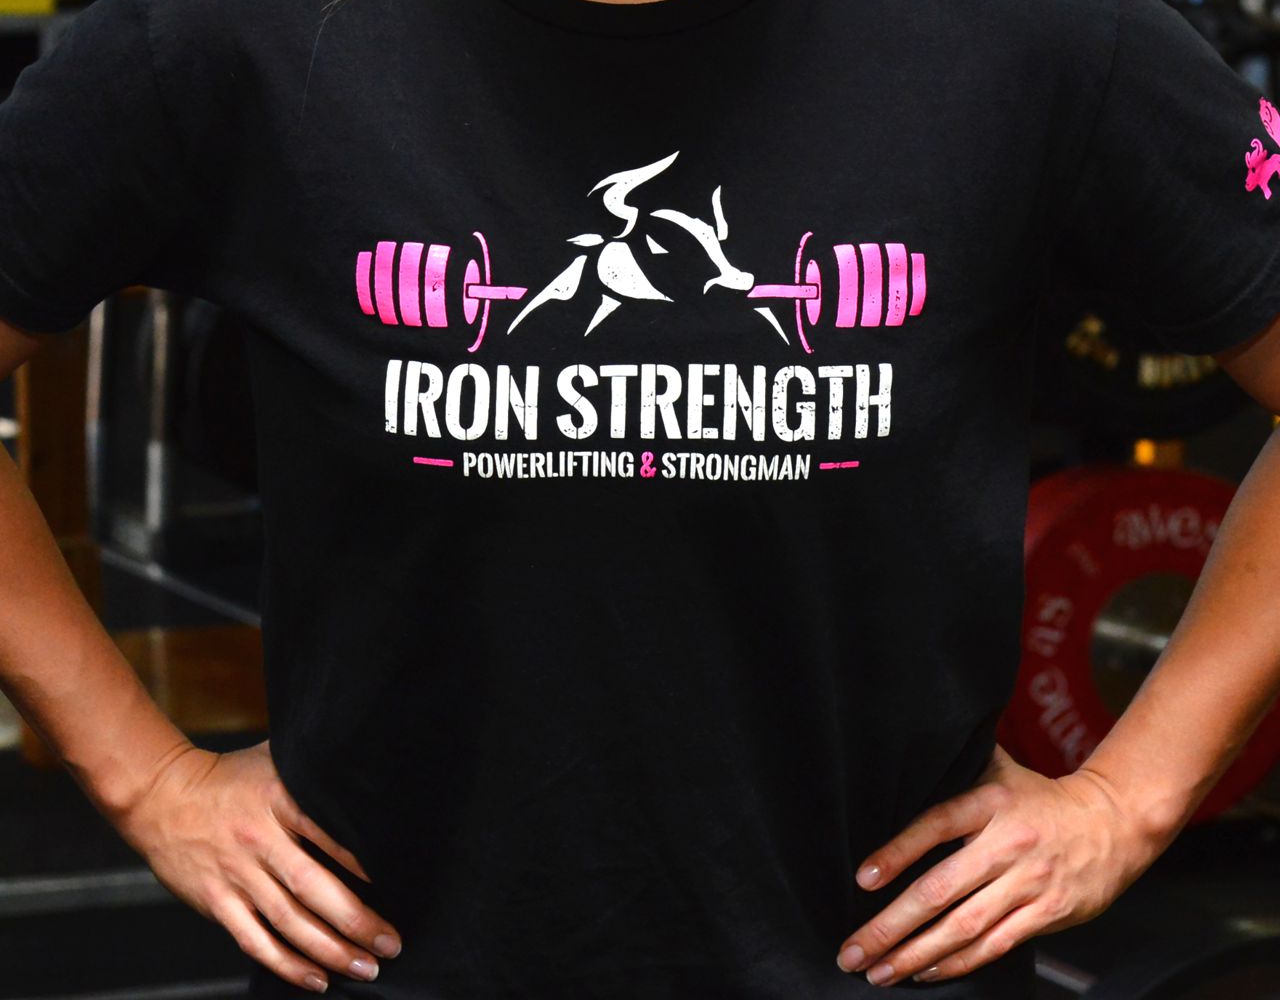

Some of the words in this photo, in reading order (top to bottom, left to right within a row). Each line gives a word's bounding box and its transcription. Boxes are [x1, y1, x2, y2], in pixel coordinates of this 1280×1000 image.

[385, 360, 539, 440] IRON
[556, 363, 892, 442] STRENGTH
[463, 451, 634, 478] POWERLIFTING
[640, 452, 656, 477] &
[662, 453, 810, 480] STRONGMAN
